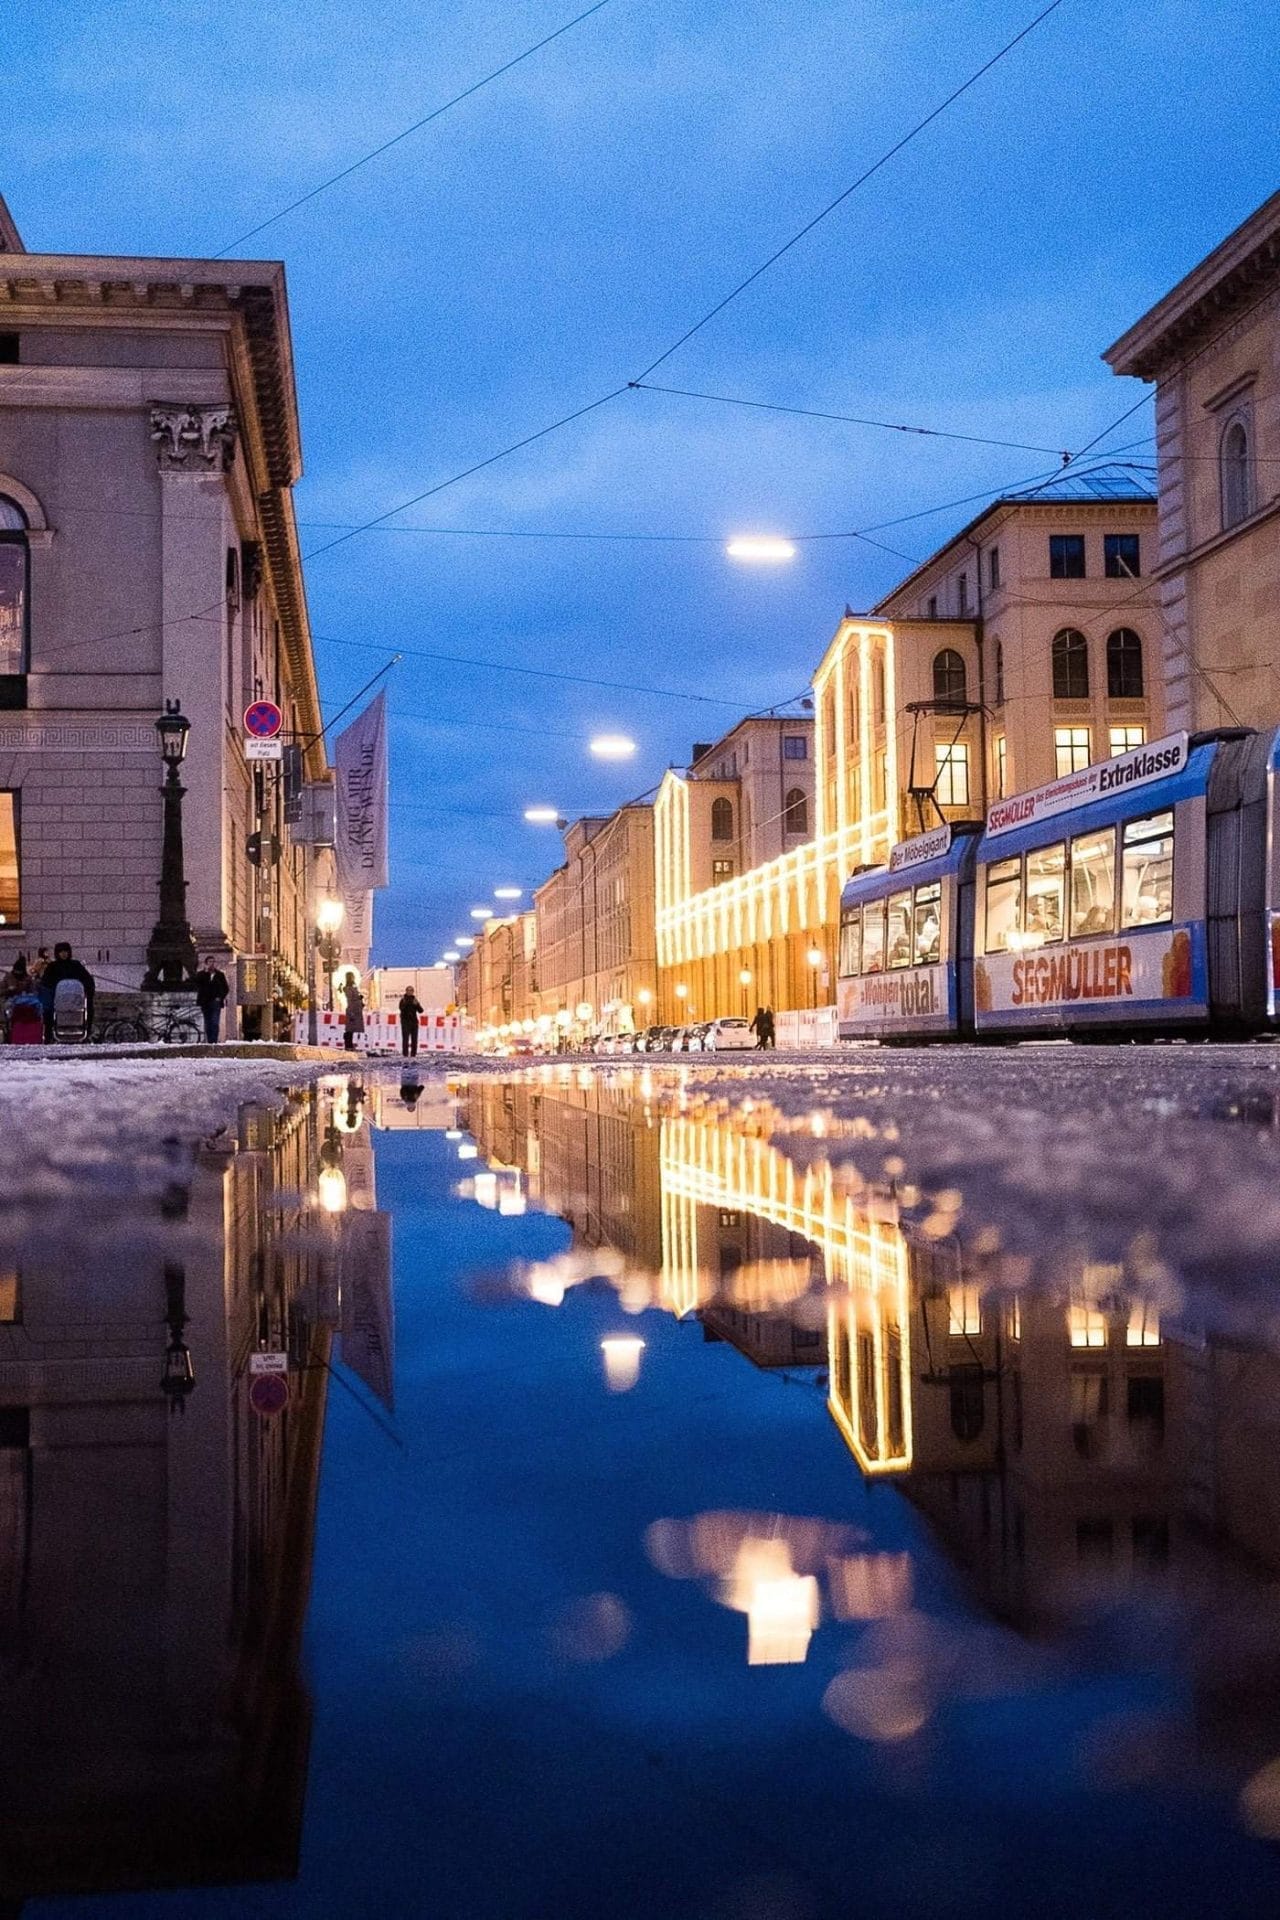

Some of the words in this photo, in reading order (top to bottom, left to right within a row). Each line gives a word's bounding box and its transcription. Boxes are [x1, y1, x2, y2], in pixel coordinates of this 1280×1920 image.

[348, 769, 361, 798] MIR
[1099, 745, 1181, 792] Extraklasse
[904, 831, 948, 863] Möbelgigant
[1011, 946, 1133, 1005] SEGMÜLLER
